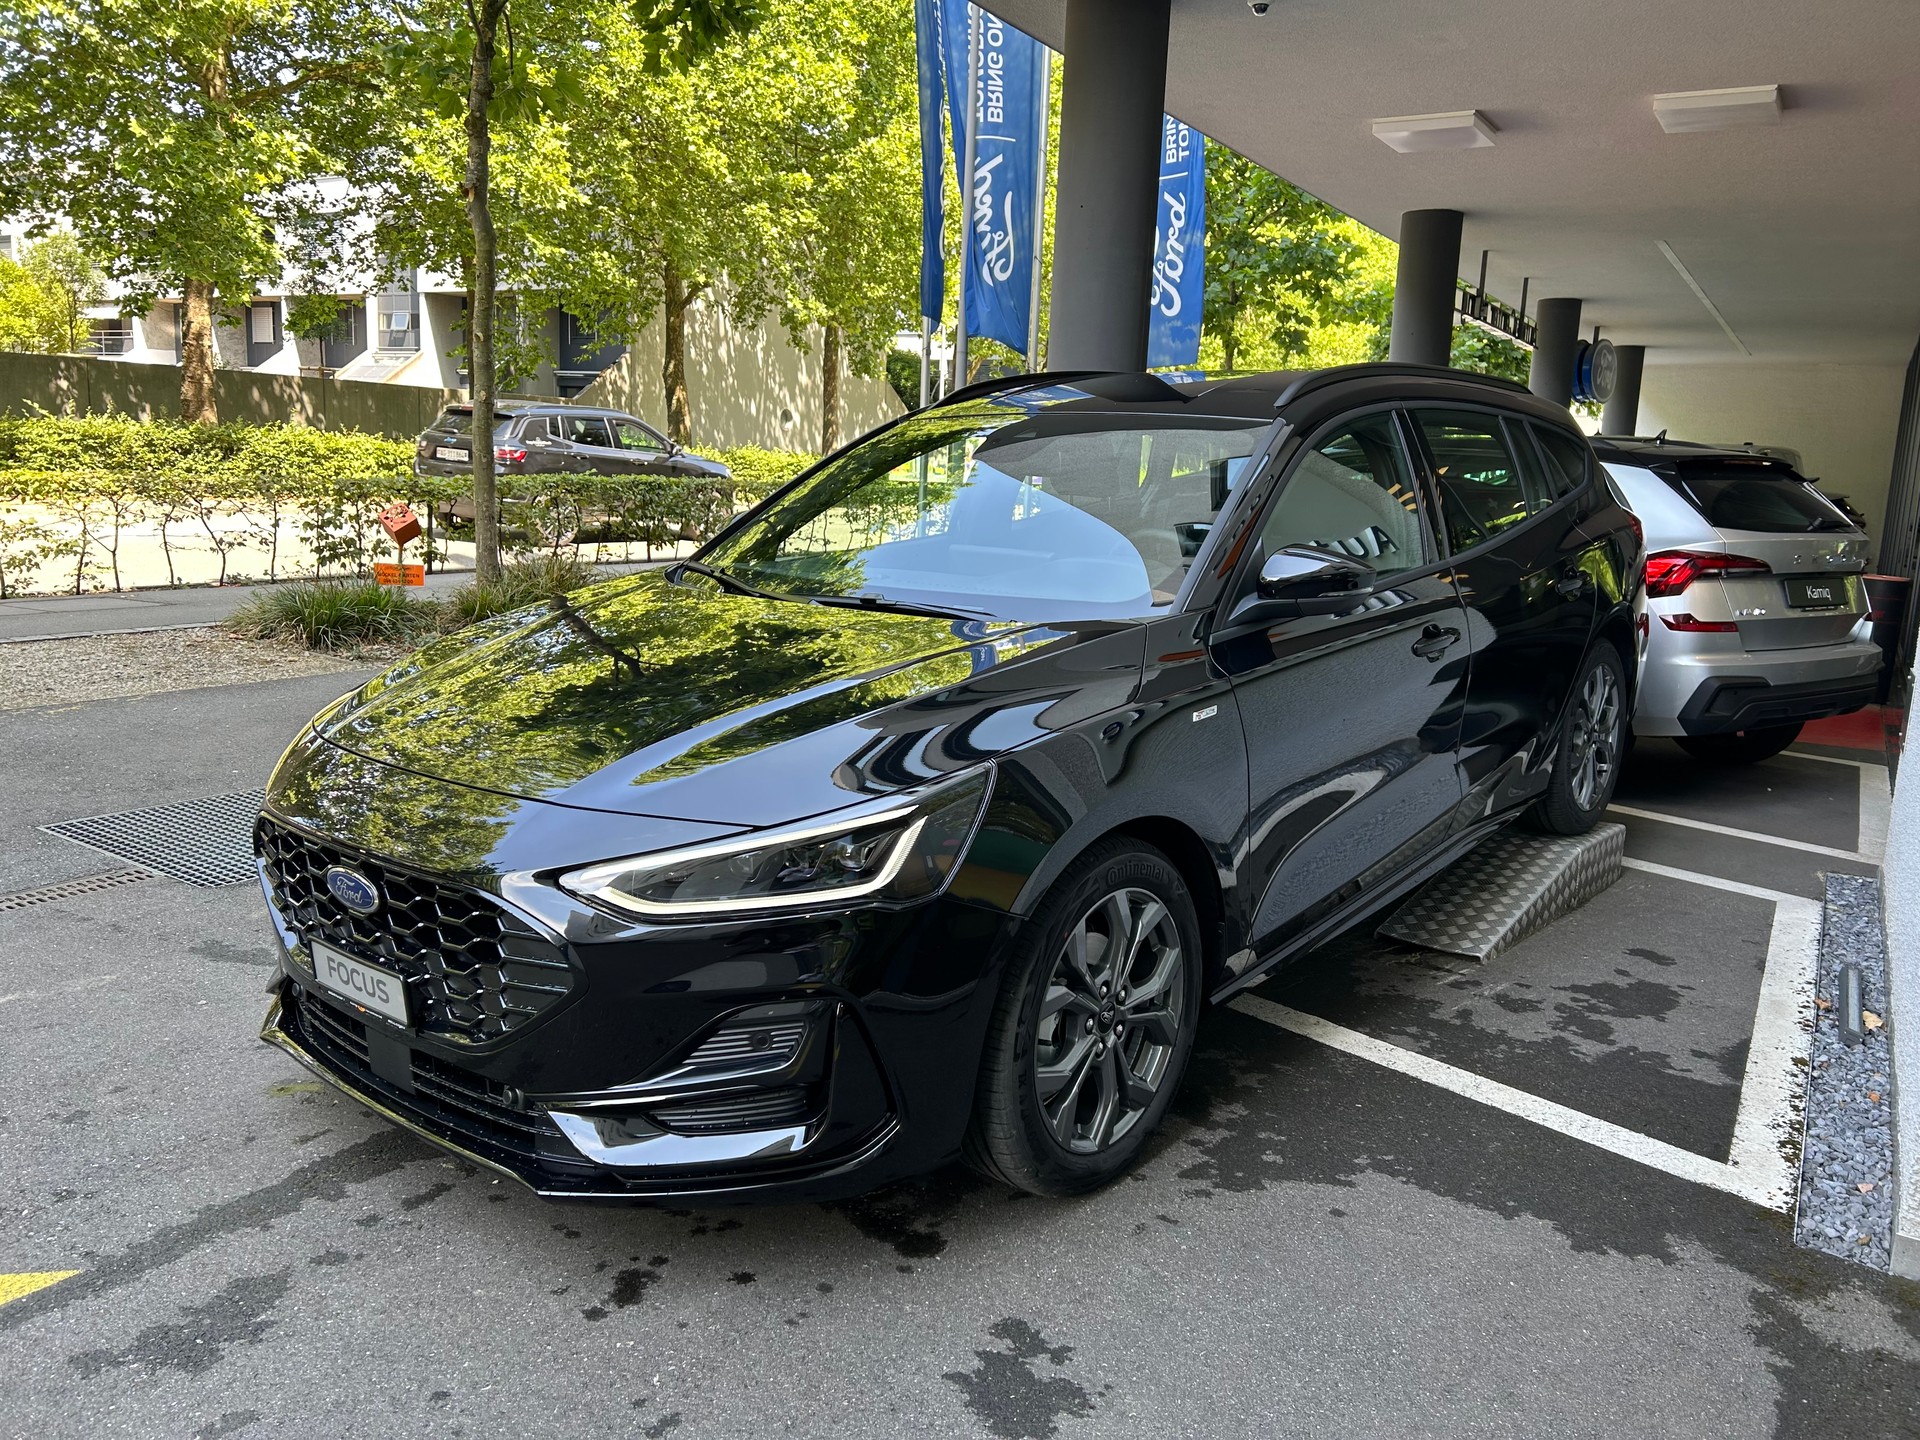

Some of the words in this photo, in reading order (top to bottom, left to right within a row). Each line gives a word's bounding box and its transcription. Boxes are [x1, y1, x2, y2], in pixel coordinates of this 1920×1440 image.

[1150, 191, 1187, 317] Ford
[1805, 585, 1832, 601] Kamiq
[1106, 860, 1165, 886] Continental
[336, 876, 363, 904] Ford
[327, 957, 390, 1003] FOCUS
